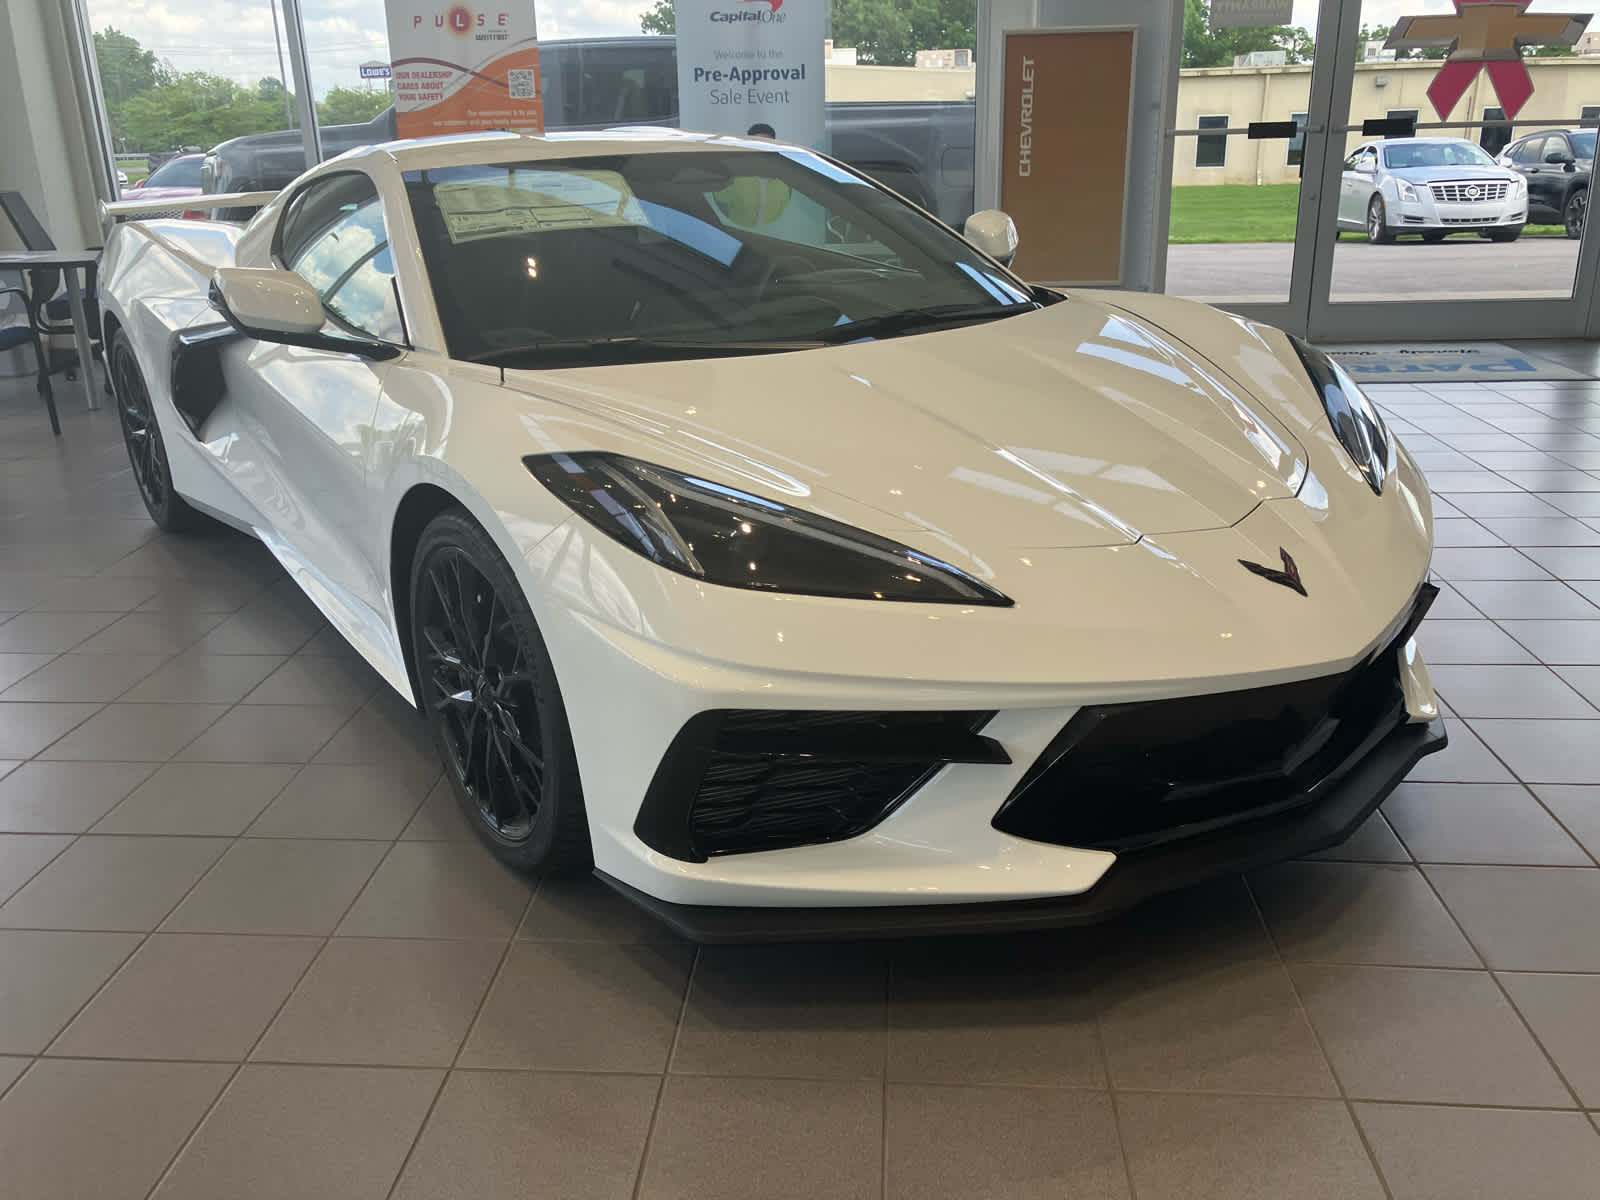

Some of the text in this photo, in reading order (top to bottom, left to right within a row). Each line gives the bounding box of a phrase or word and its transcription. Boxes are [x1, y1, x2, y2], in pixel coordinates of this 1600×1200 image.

[413, 13, 507, 28] PULSE
[694, 64, 806, 85] Pre-Approval
[710, 88, 790, 105] Sale Event
[1019, 55, 1034, 177] CHEVROLET
